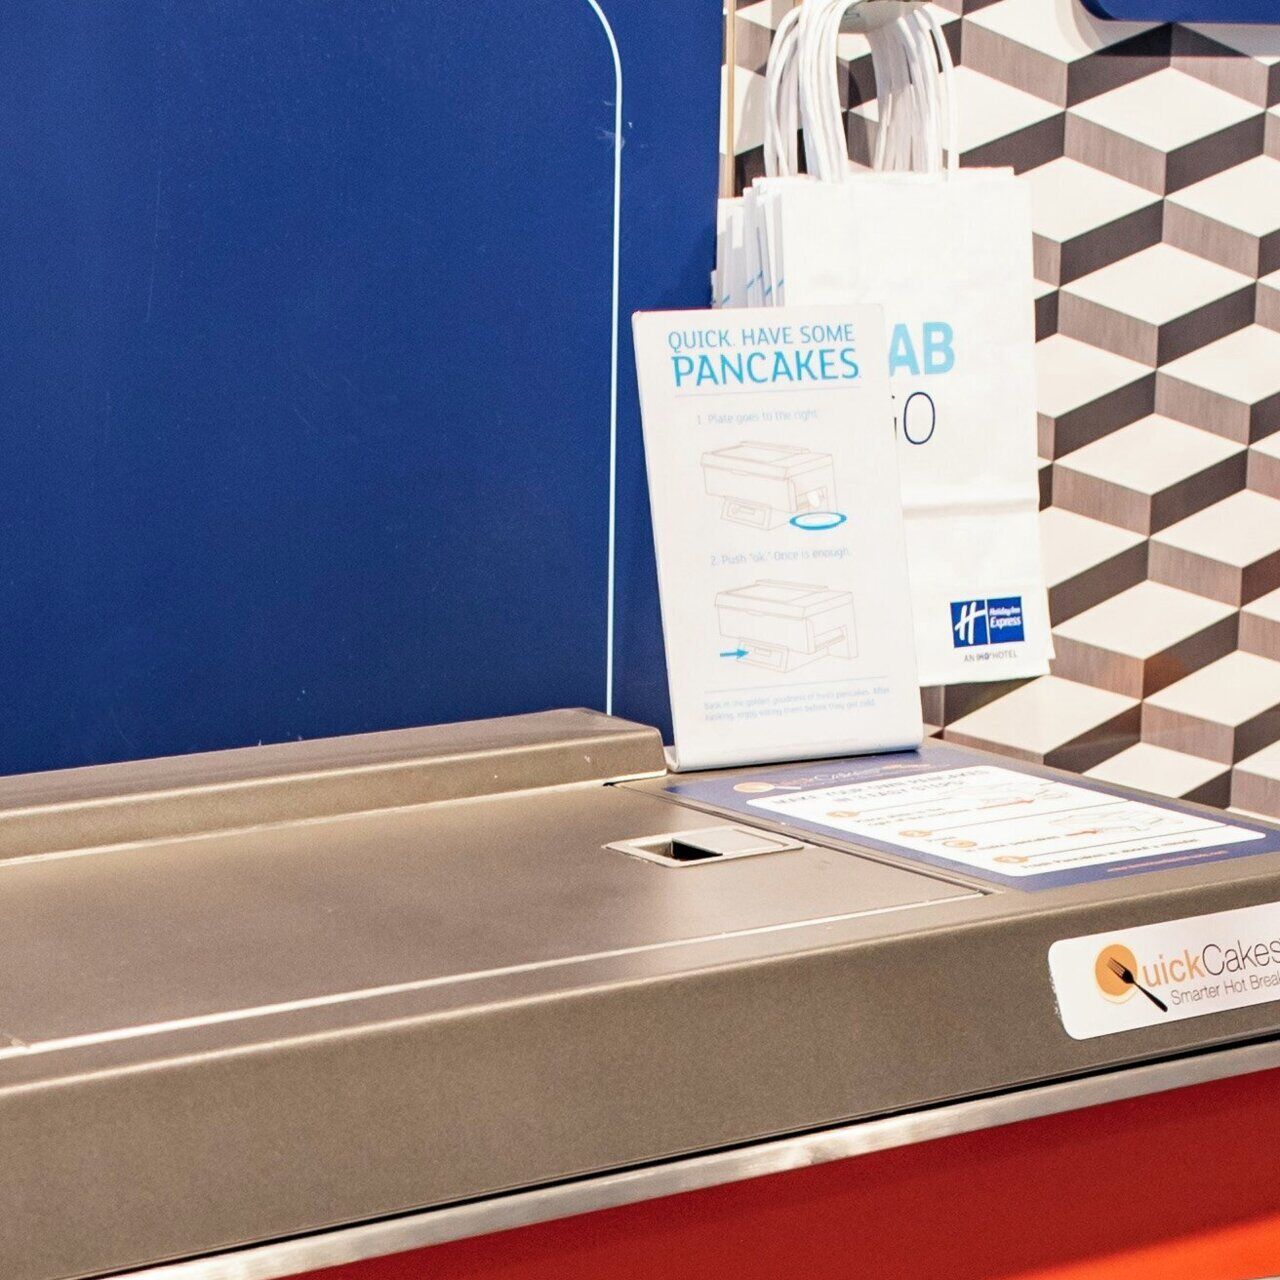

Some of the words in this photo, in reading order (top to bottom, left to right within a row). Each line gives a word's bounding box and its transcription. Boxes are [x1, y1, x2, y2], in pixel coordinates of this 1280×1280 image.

[742, 326, 794, 347] HAVE
[800, 323, 856, 345] SOME
[891, 391, 936, 445] O
[990, 616, 1022, 630] Express
[1170, 985, 1220, 1006] Smarter
[1224, 978, 1248, 995] Hot
